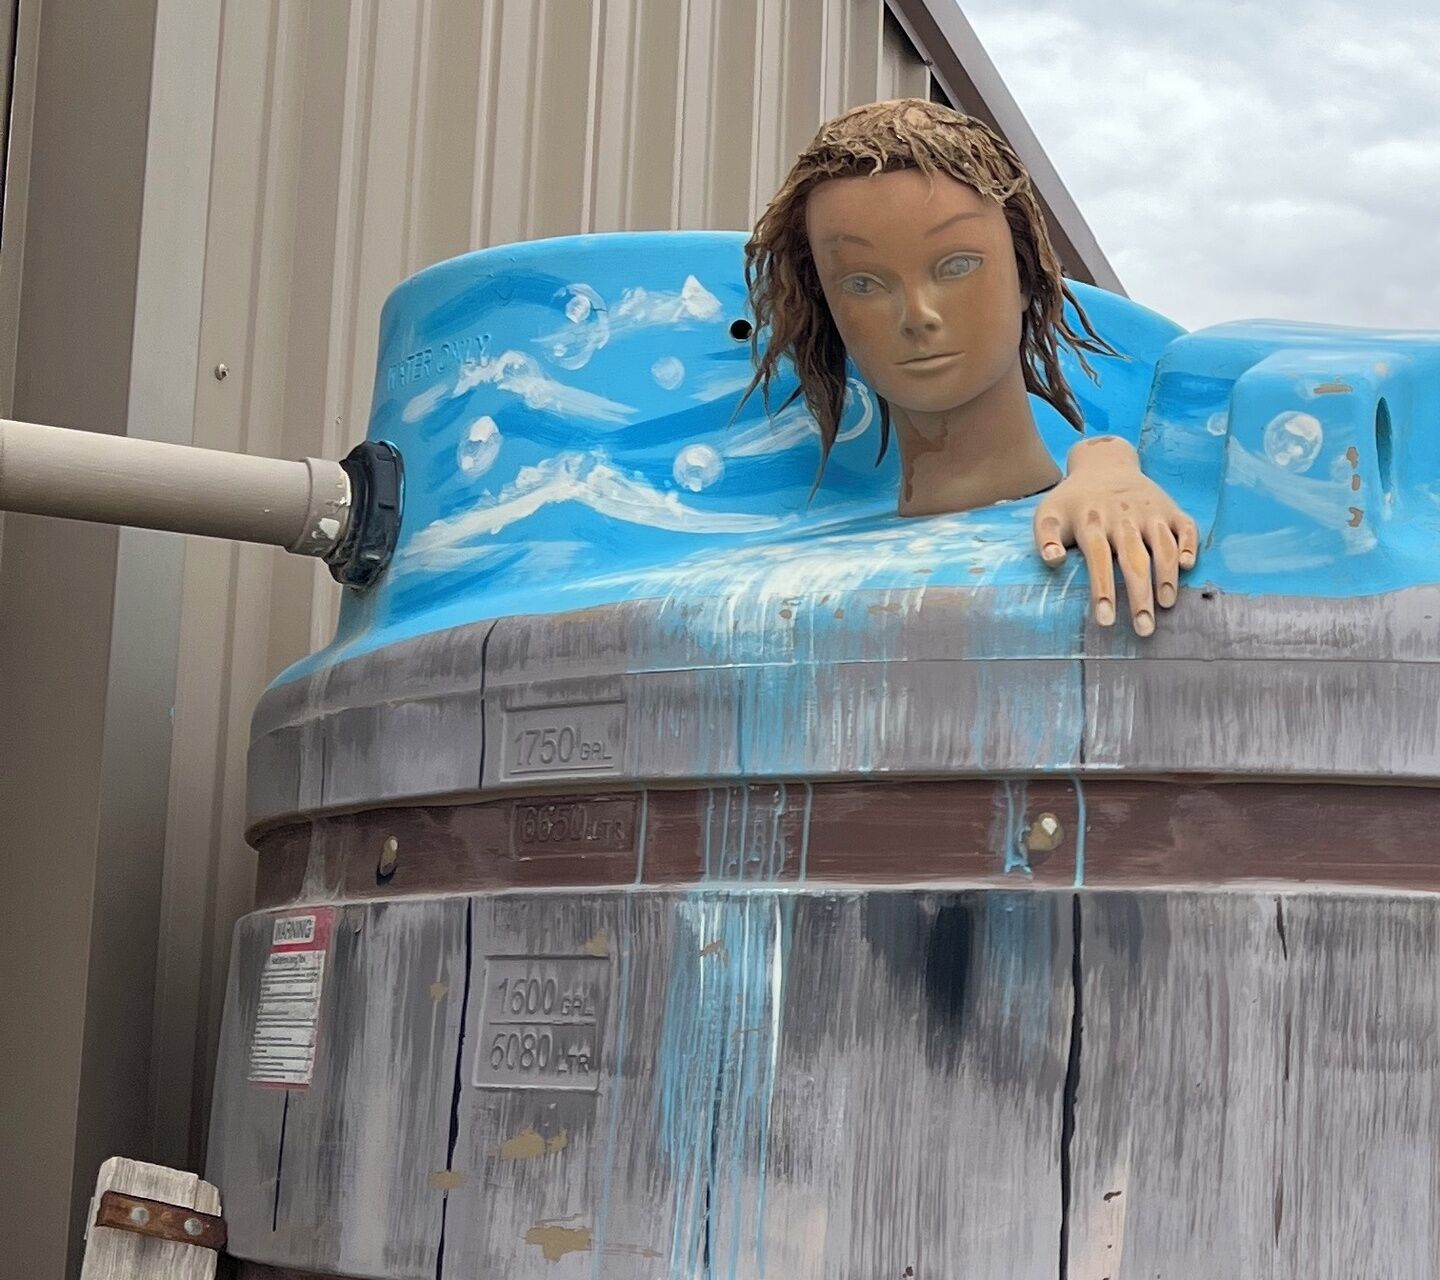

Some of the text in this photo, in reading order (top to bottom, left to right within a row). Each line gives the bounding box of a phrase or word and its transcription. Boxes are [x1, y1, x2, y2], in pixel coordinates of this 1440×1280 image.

[514, 725, 612, 766] 1750 GAL
[519, 803, 588, 843] 6650
[274, 919, 312, 941] WARNING
[498, 977, 595, 1016] 1600 GAL
[490, 1031, 591, 1074] 6080 LTR
